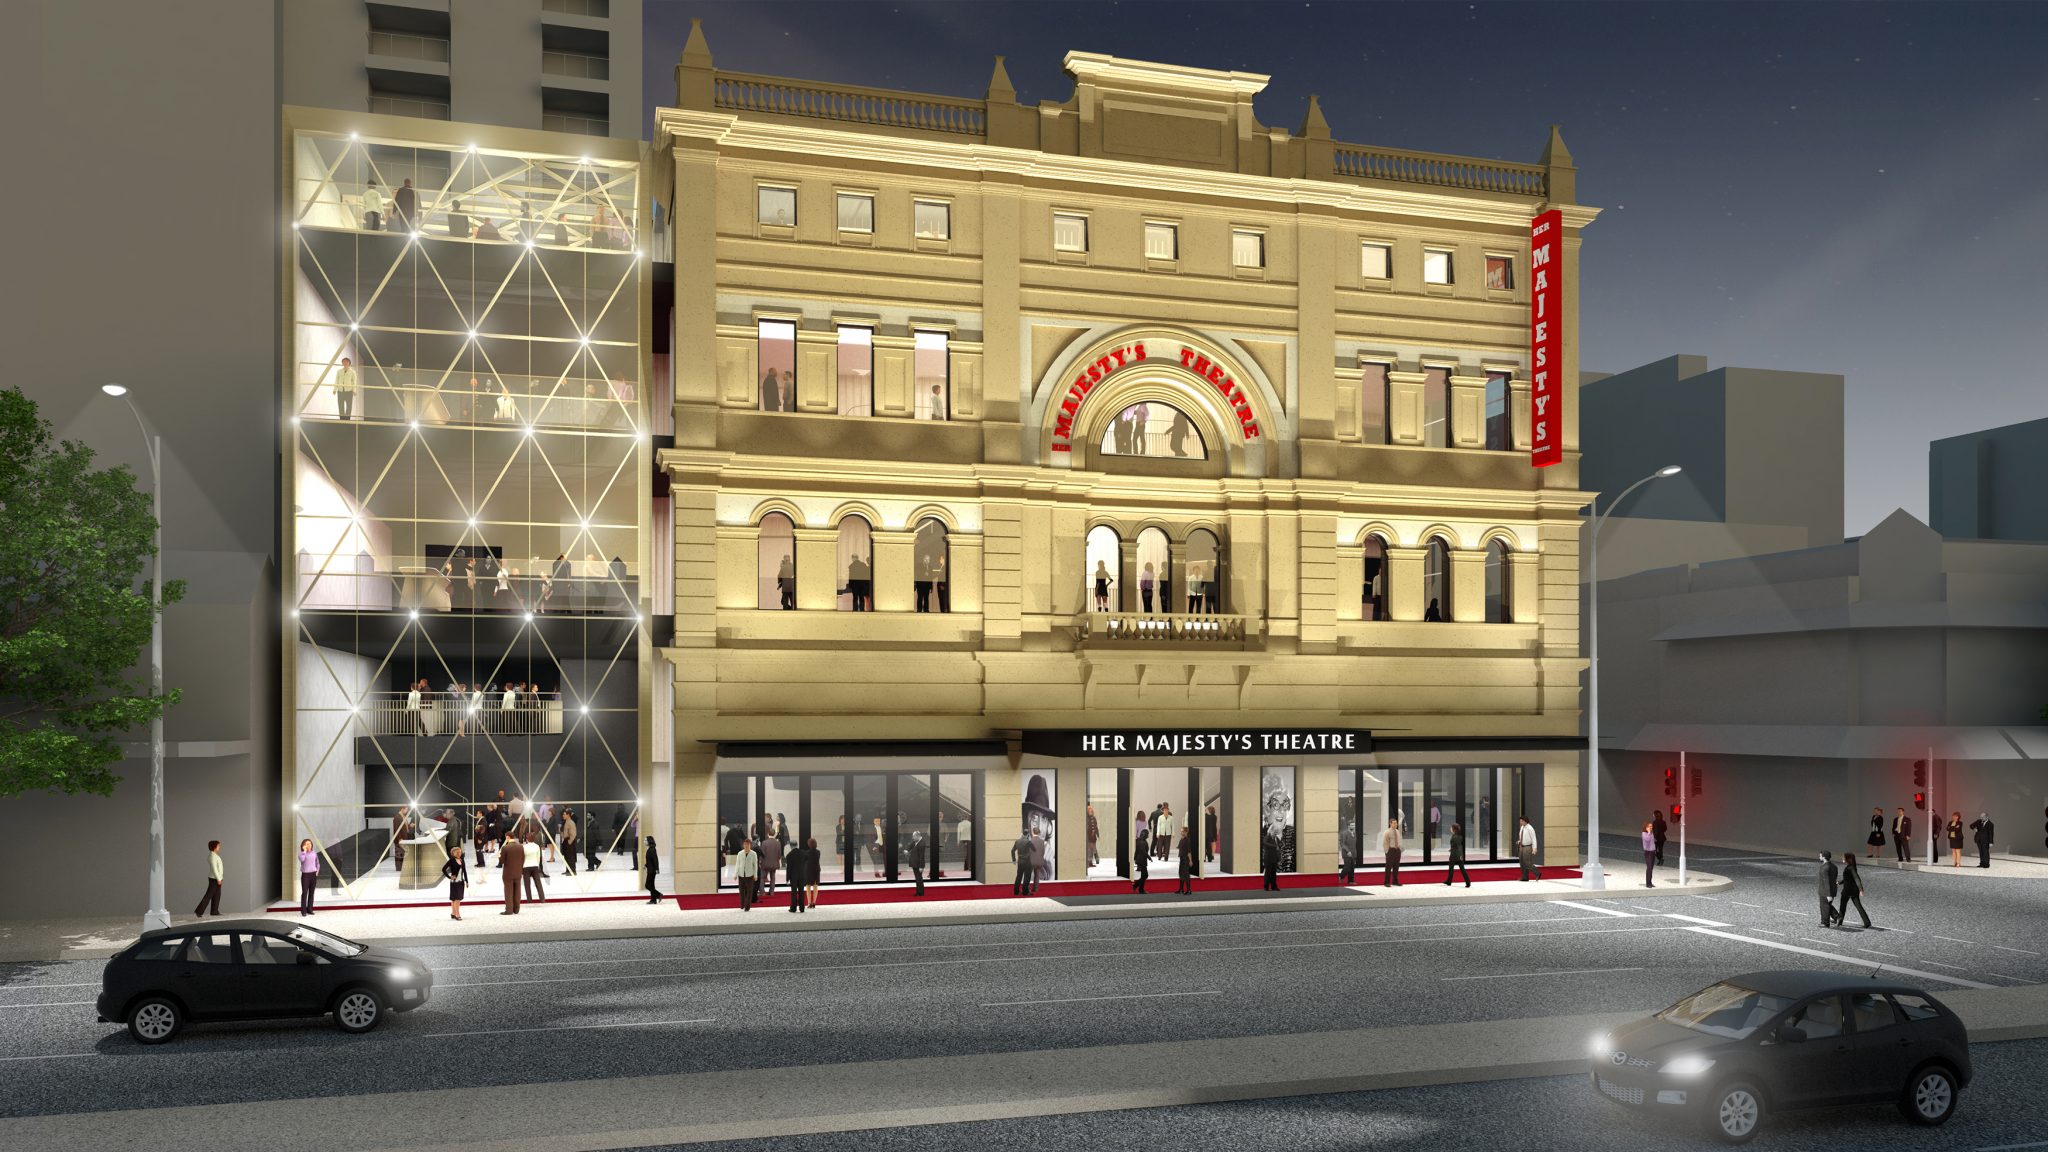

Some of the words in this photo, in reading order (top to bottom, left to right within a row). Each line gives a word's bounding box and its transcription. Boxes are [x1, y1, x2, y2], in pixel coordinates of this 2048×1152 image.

[1532, 222, 1550, 237] HER
[1532, 243, 1550, 442] MAJESTY'S
[1054, 344, 1147, 439] MAJESTY'S
[1180, 348, 1260, 440] THEATRE
[1082, 735, 1126, 751] HER
[1136, 734, 1252, 754] MAJESTY'S
[1260, 734, 1355, 750] THEATRE
